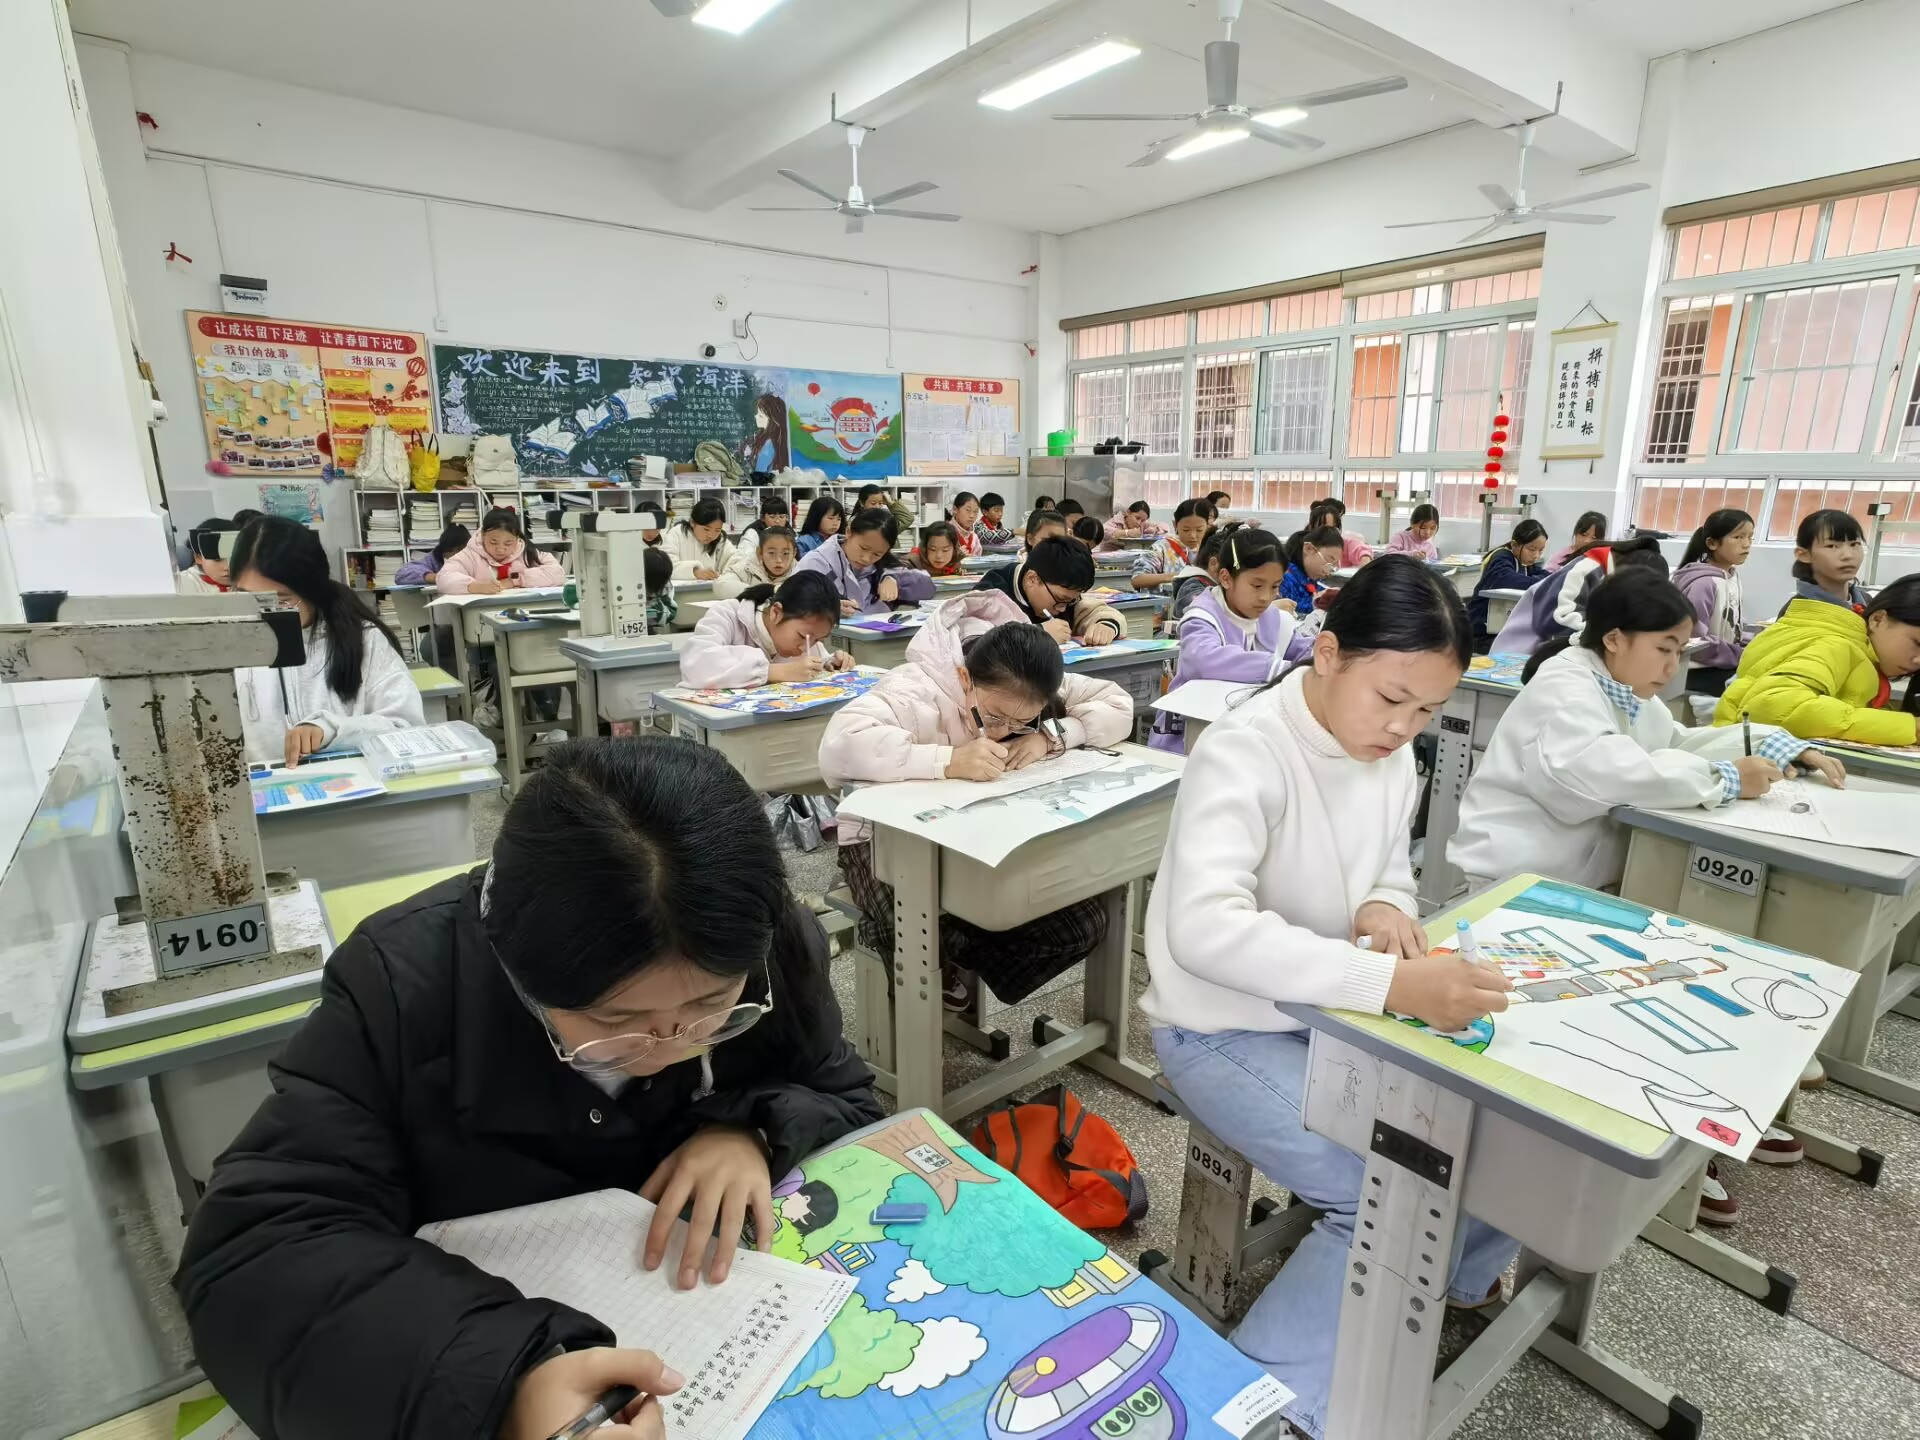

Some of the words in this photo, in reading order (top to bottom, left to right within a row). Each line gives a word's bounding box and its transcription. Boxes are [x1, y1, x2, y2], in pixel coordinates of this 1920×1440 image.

[214, 320, 308, 343] 让成长留下足迹
[320, 331, 405, 351] 让青春留下记忆
[223, 344, 289, 360] 我们的故事
[351, 355, 398, 368] 班级风采
[457, 349, 601, 387] 欢迎来到
[628, 361, 748, 399] 知识海洋
[1580, 346, 1604, 437] 拼搏目标
[622, 621, 644, 635] 2541
[1697, 856, 1755, 886] 0920
[167, 919, 259, 957] 0914
[1191, 1145, 1233, 1184] 0894
